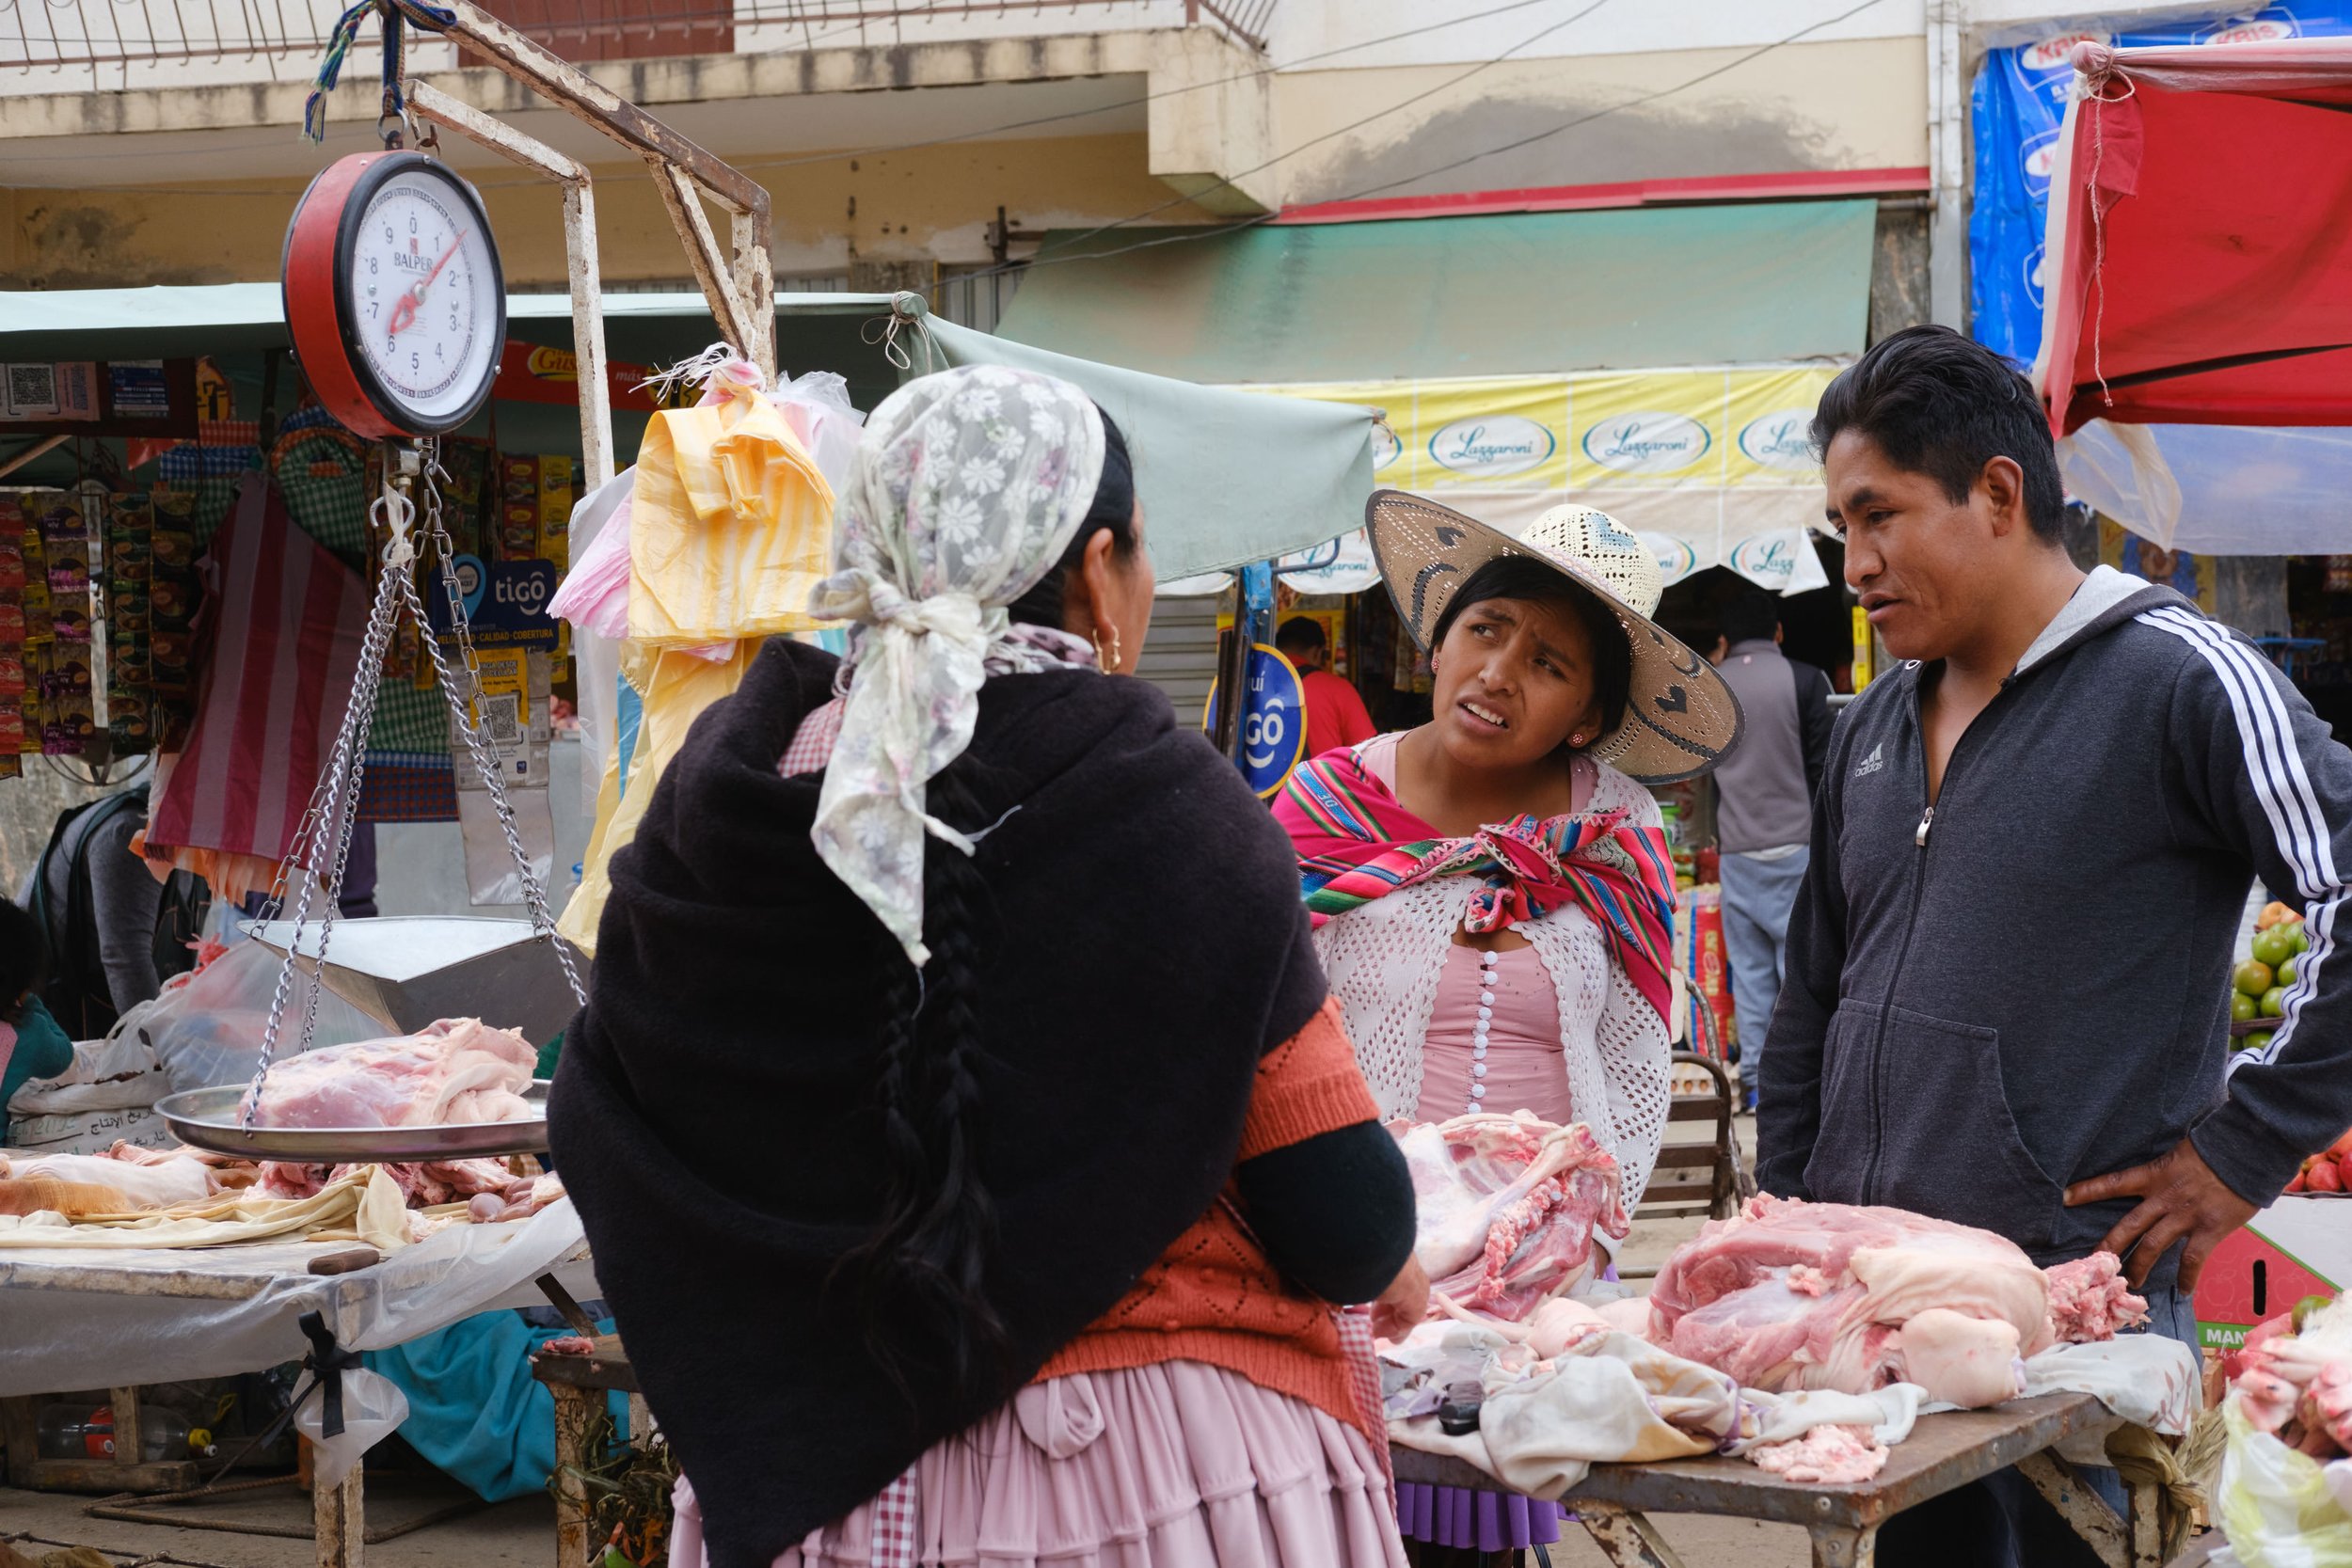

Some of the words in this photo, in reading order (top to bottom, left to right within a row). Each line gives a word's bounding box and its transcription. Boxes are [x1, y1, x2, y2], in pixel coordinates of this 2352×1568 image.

[410, 217, 417, 234] 0
[386, 227, 393, 245] 9
[435, 236, 440, 252] 1
[370, 257, 378, 275] 8
[394, 251, 433, 272] BALPER
[449, 270, 456, 287] 2
[372, 302, 379, 319] 7
[450, 314, 456, 332] 3
[388, 335, 395, 353] 6
[435, 342, 442, 359] 4
[412, 352, 419, 370] 5
[537, 349, 577, 372] Gus
[615, 370, 641, 382] más
[1451, 426, 1533, 463] Lazzaroni
[1605, 422, 1689, 460] Lazzaroni
[480, 631, 509, 641] CALIDAD
[513, 628, 553, 640] COBERTURA
[1854, 760, 1883, 778] adidas
